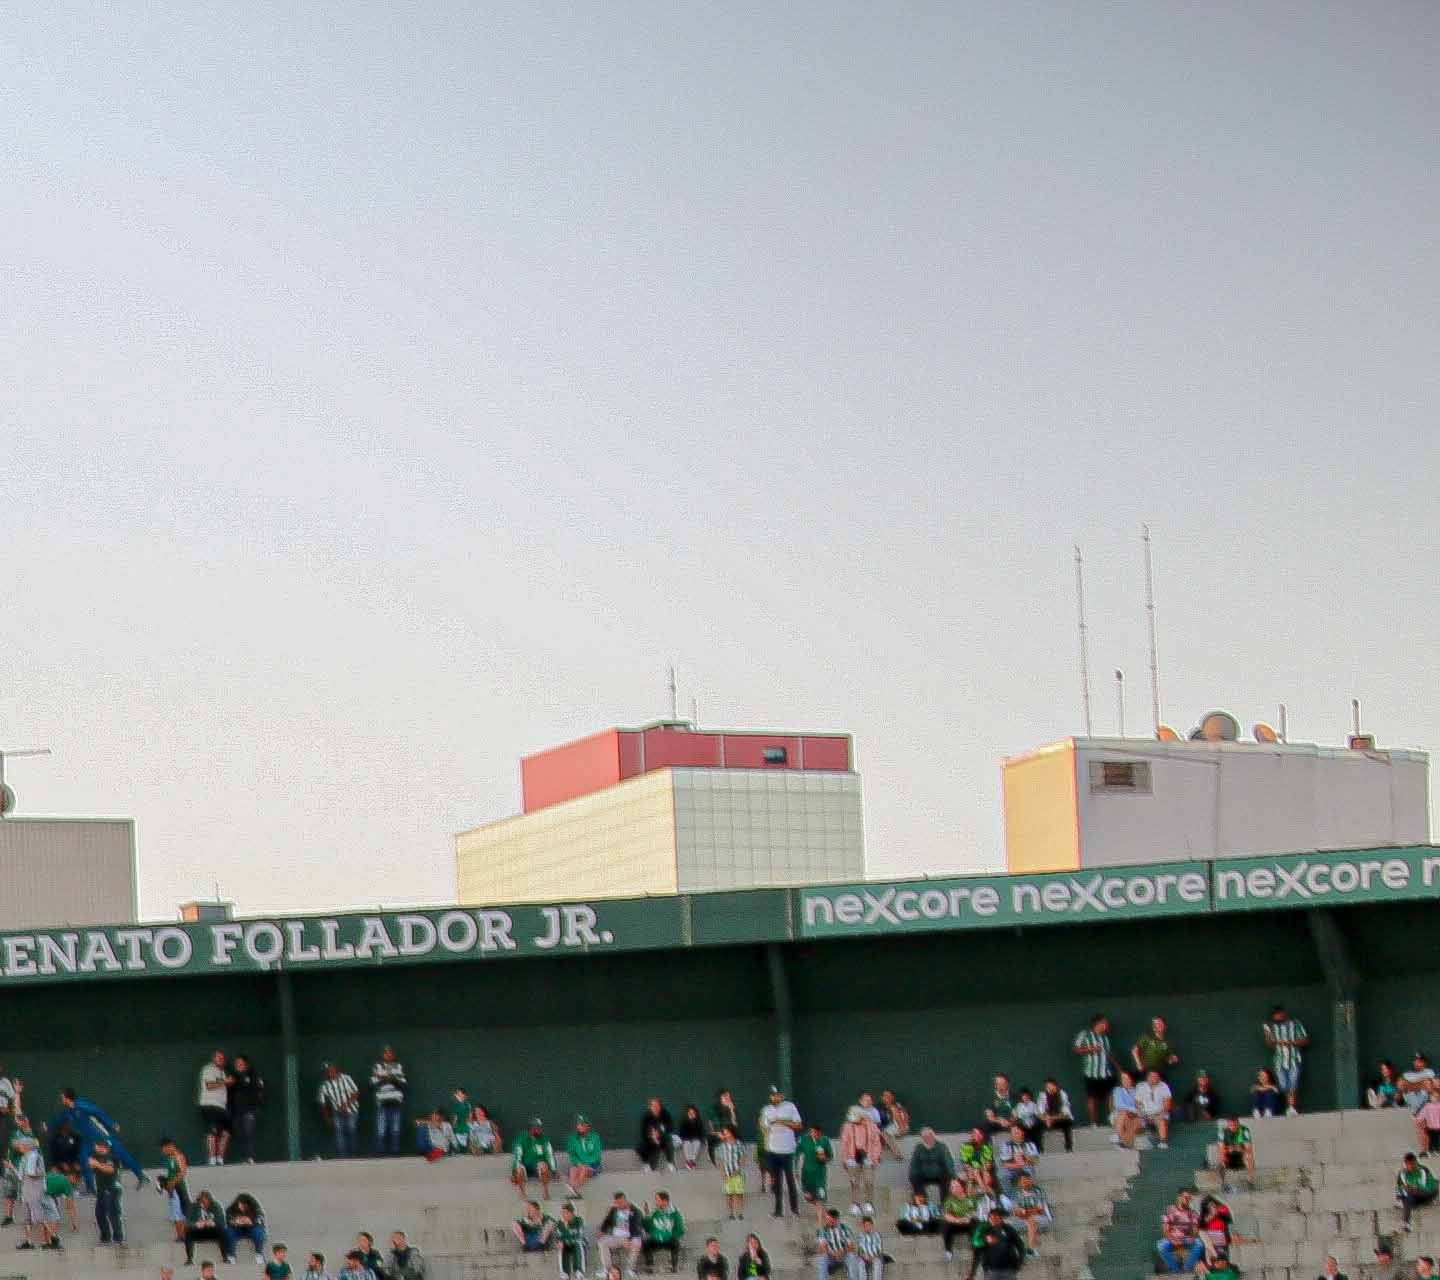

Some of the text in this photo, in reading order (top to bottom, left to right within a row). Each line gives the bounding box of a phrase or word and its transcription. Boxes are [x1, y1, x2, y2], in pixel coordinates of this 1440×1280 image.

[803, 881, 1001, 928] nexcore
[1011, 868, 1209, 915] nexcore
[1216, 855, 1411, 901] nexcore
[210, 907, 518, 970] FOLLADOR
[533, 902, 616, 950] JR.
